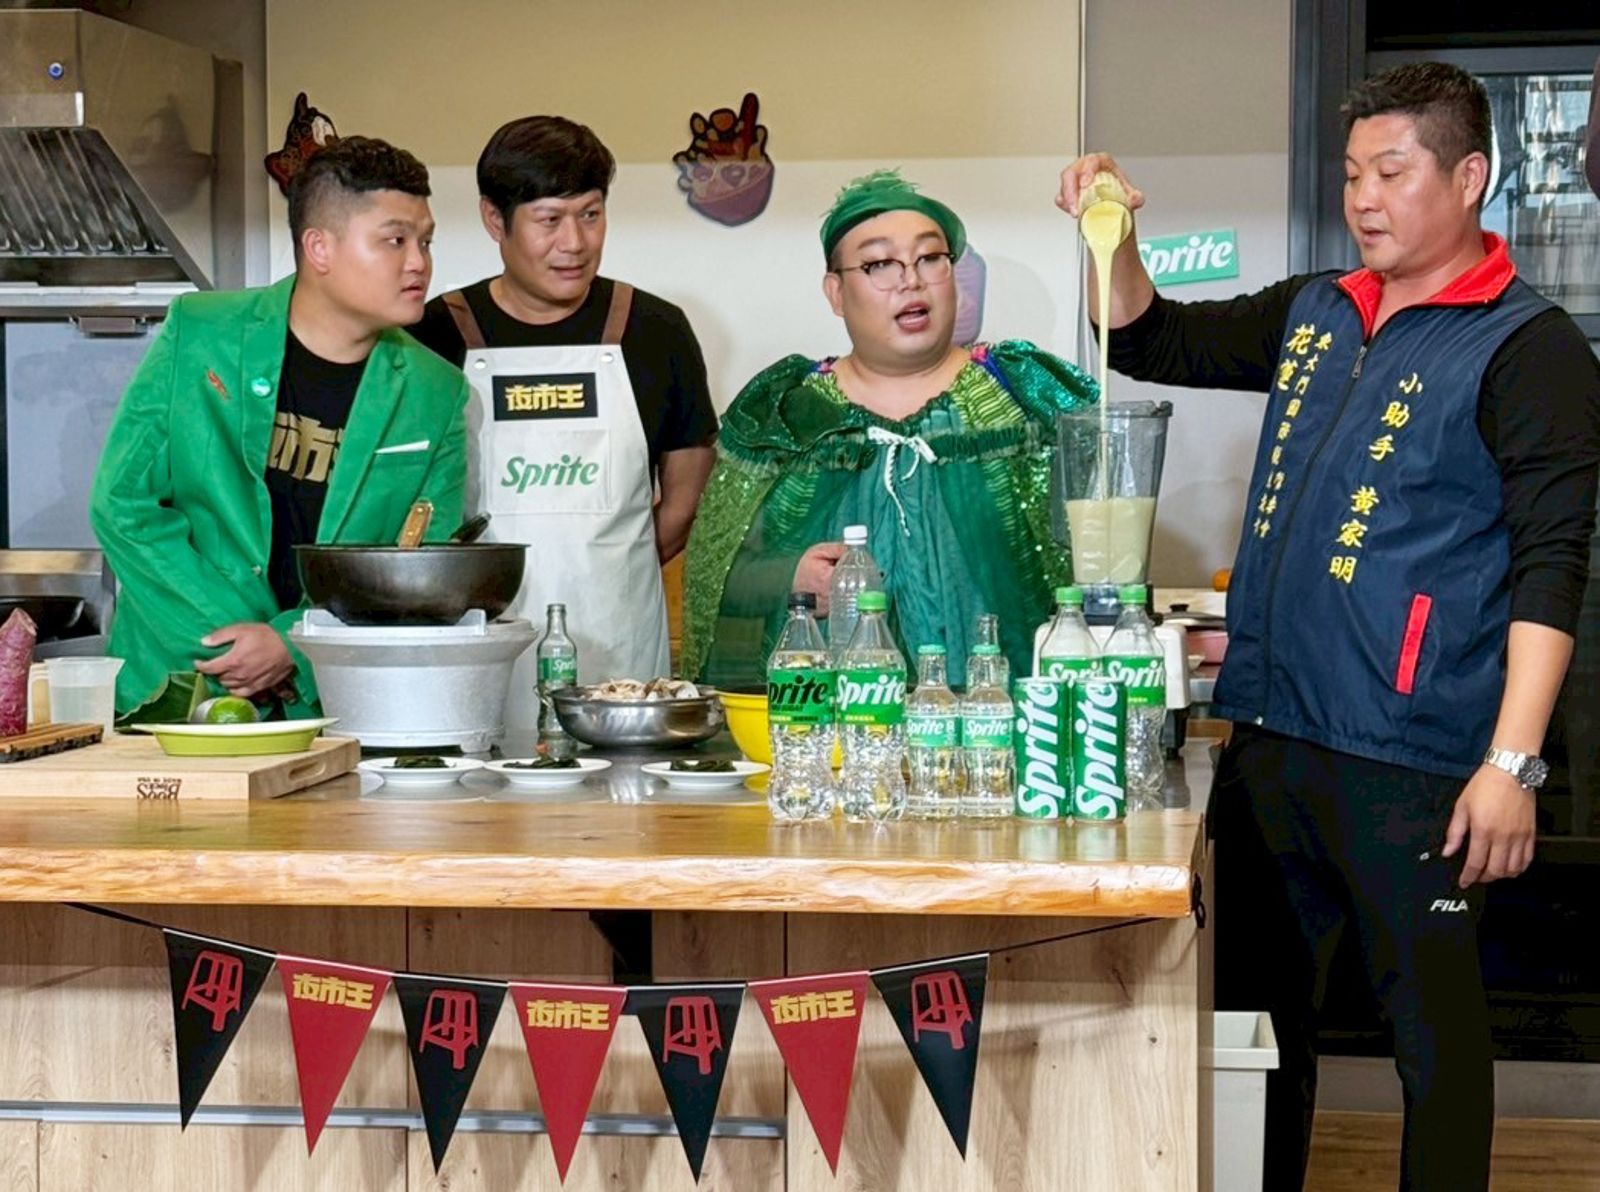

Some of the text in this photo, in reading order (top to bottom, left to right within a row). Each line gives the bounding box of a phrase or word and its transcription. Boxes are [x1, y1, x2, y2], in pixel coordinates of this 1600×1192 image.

[505, 383, 585, 411] 夜市王
[501, 454, 600, 494] Sprite
[1329, 372, 1423, 584] 小助手 黃家明
[768, 674, 829, 705] prite
[836, 674, 906, 711] Sprite
[965, 719, 1009, 738] Sprite
[1016, 681, 1066, 819] Sprite
[1074, 681, 1124, 820] Sprite
[1430, 899, 1468, 912] FILA
[292, 973, 375, 1010] 夜市王
[769, 989, 857, 1025] 夜市王
[526, 999, 610, 1031] 夜市王
